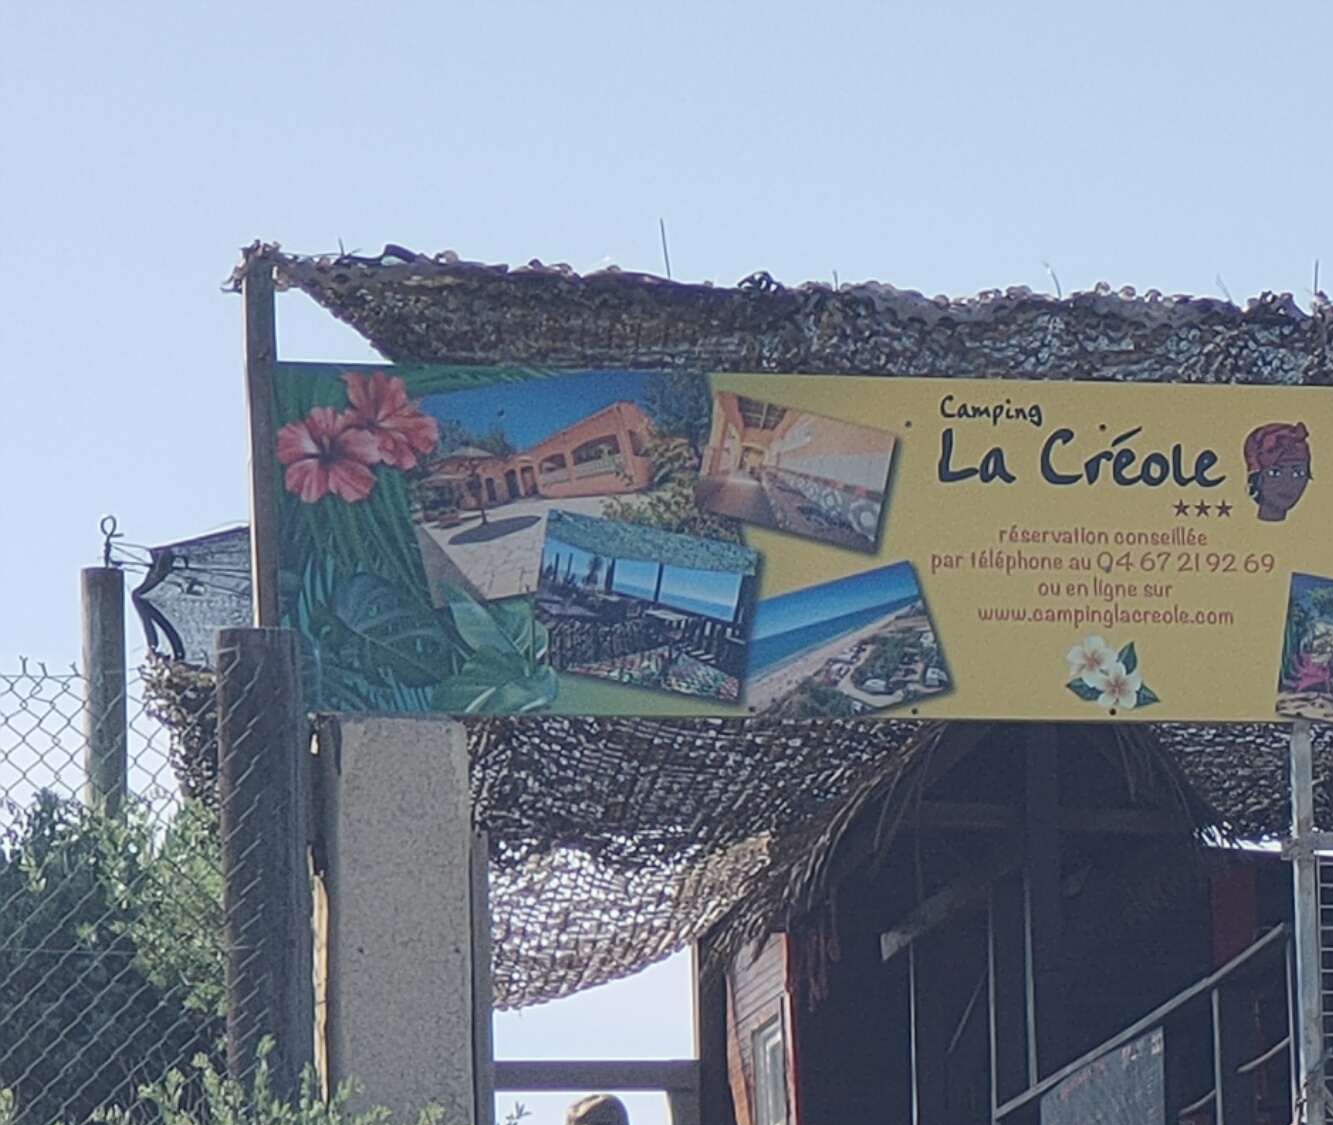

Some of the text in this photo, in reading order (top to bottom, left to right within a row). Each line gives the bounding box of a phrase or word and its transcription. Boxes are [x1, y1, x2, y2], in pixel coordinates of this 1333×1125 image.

[940, 394, 1043, 427] Camping
[938, 426, 1226, 487] La Créole
[999, 525, 1208, 547] réservation conseillée
[931, 550, 1275, 576] par téléphone au 04 67 21 92 69
[1037, 576, 1173, 602] ou en ligne sur
[977, 602, 1234, 629] www.campinglacreole.com
